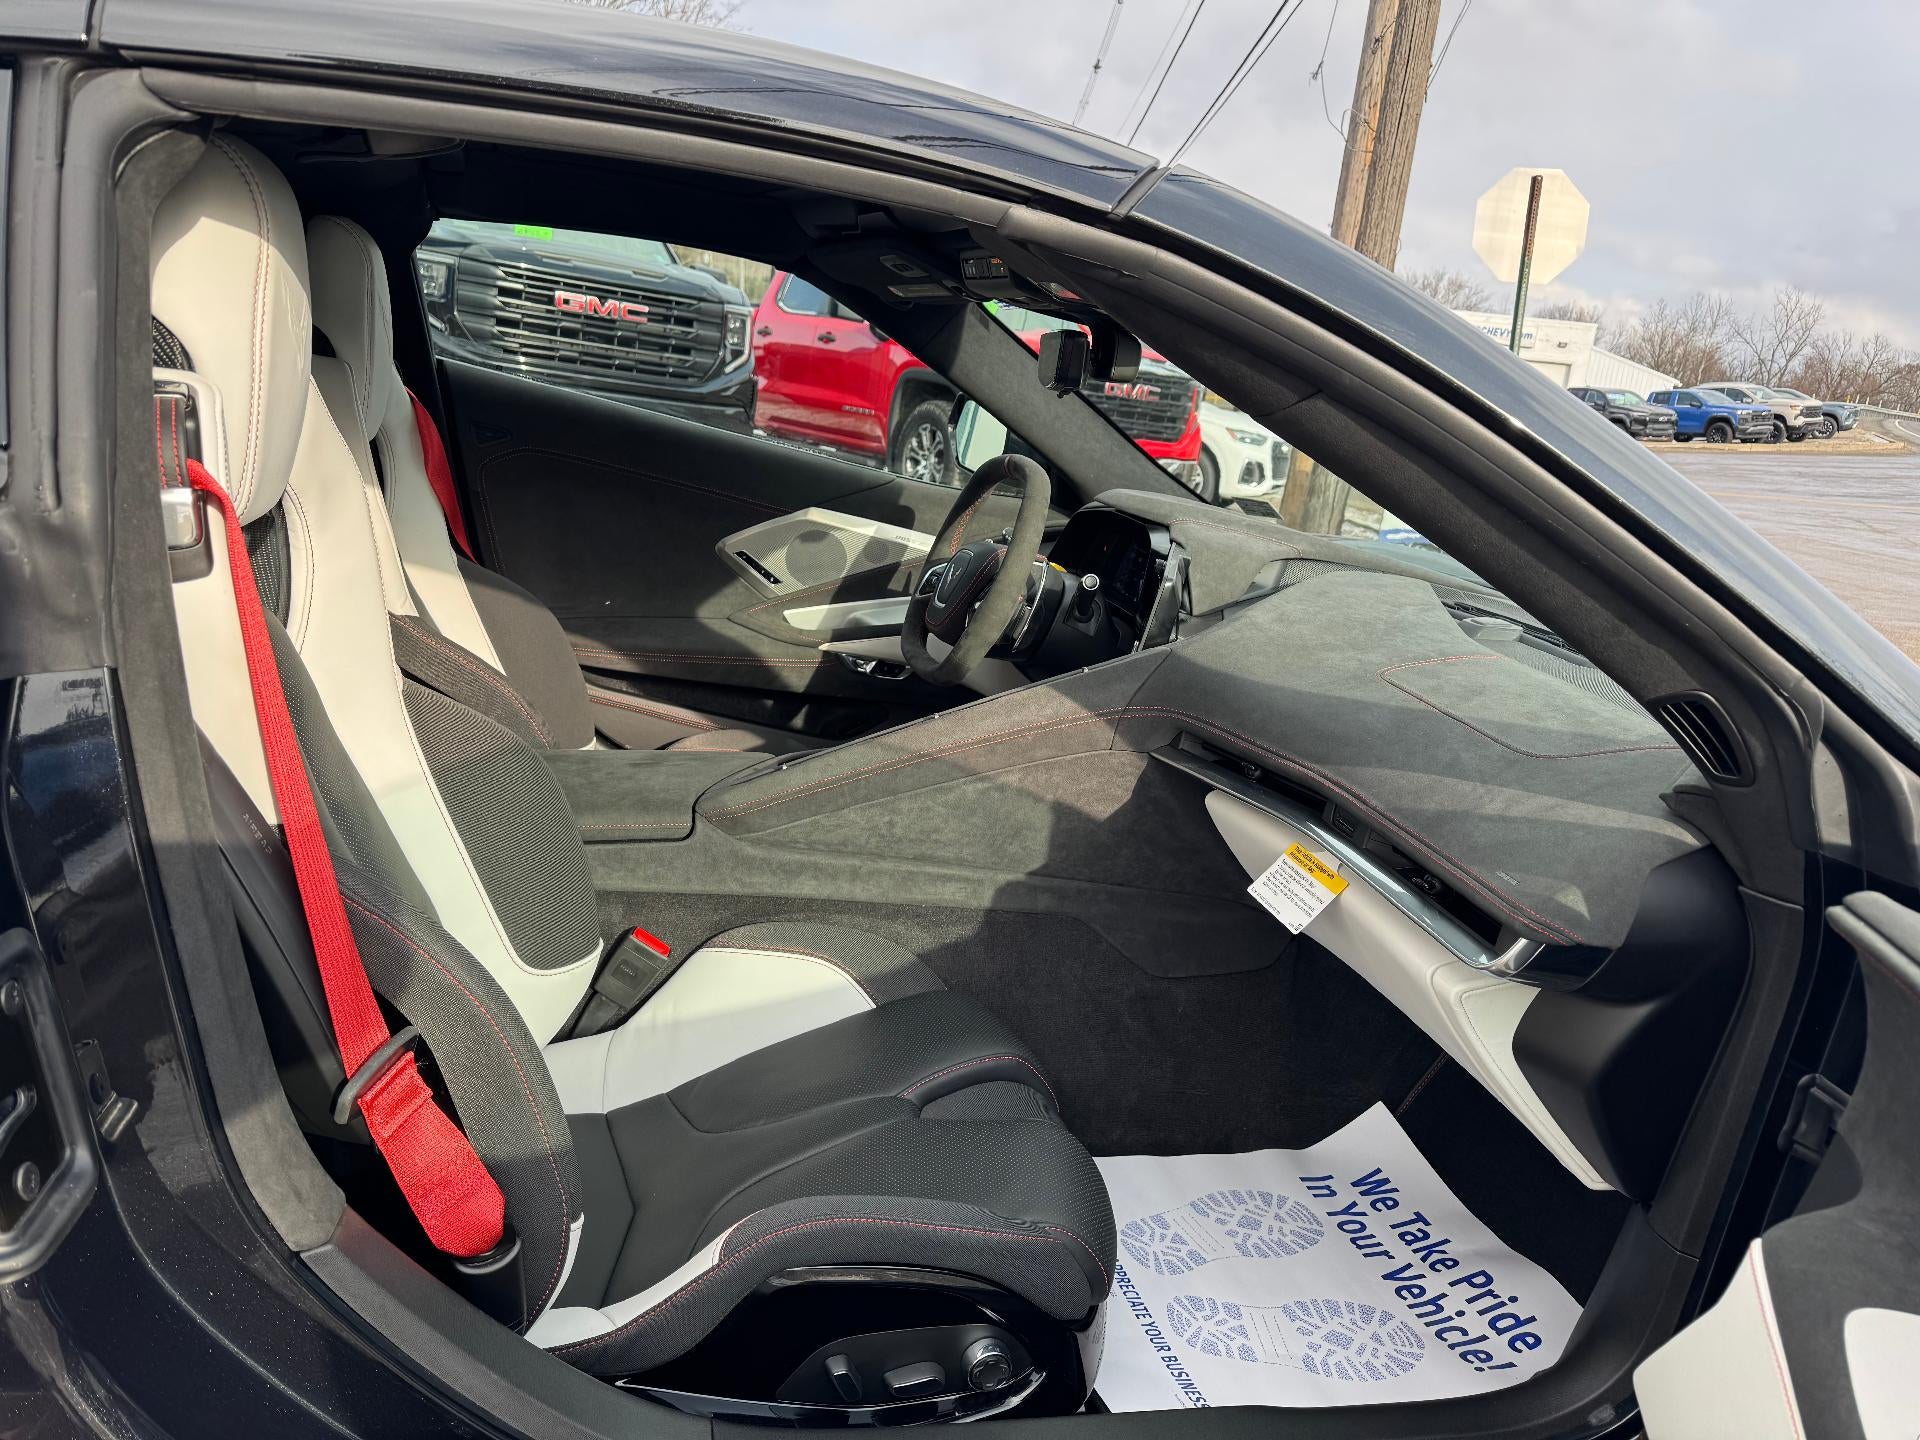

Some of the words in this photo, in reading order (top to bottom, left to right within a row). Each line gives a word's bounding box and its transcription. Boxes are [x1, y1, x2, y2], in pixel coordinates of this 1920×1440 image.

[554, 290, 650, 324] GMC
[1104, 381, 1162, 401] GMC
[1114, 1258, 1152, 1320] PPRECIATE
[1141, 1321, 1172, 1353] YOUR
[1299, 1174, 1338, 1198] In
[1326, 1200, 1396, 1260] Your
[1381, 1262, 1518, 1372] Vehicle!
[1350, 1167, 1400, 1212] We
[1389, 1211, 1460, 1273] Take
[1448, 1269, 1543, 1353] Pride
